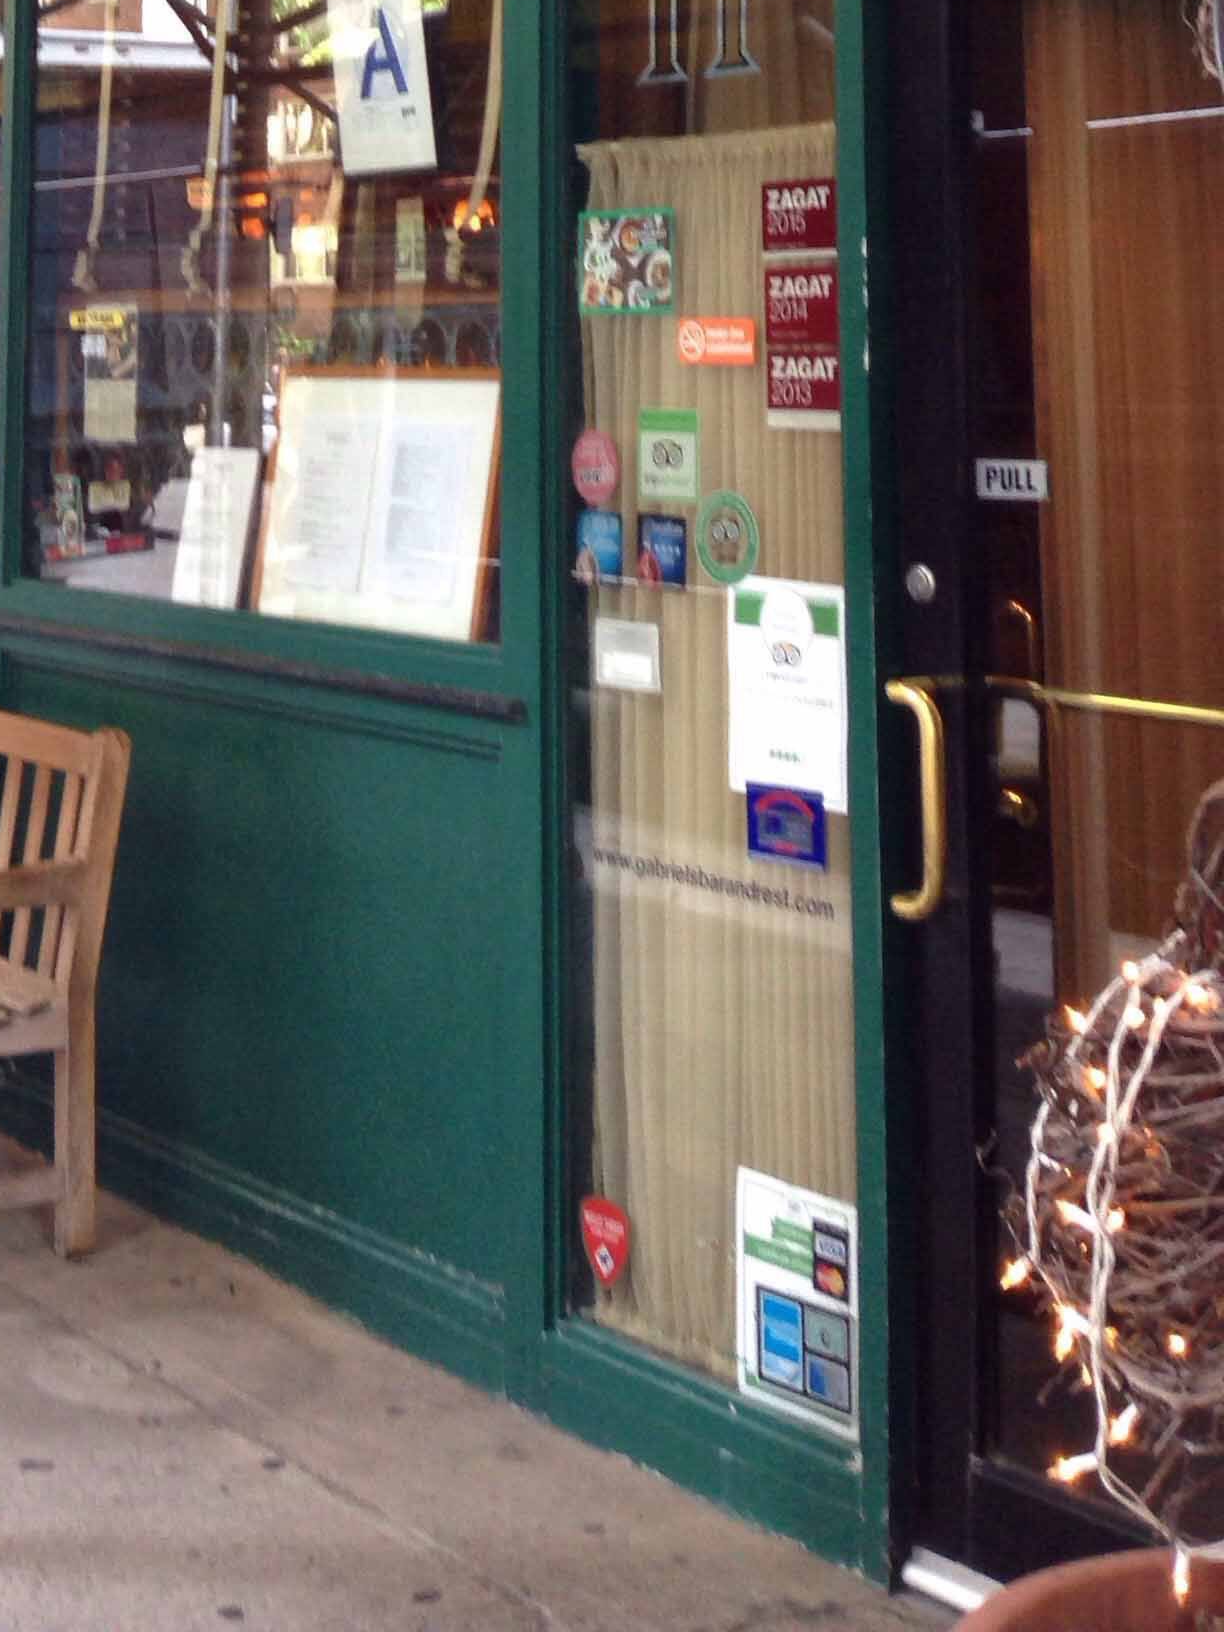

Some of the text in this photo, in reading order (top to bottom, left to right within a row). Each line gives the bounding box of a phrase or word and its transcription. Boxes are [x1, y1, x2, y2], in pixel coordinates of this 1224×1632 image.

[360, 6, 409, 100] A
[766, 185, 831, 211] ZAGAT
[768, 274, 833, 299] ZAGAT
[771, 355, 839, 381] ZAGAT
[985, 464, 1039, 492] PULL
